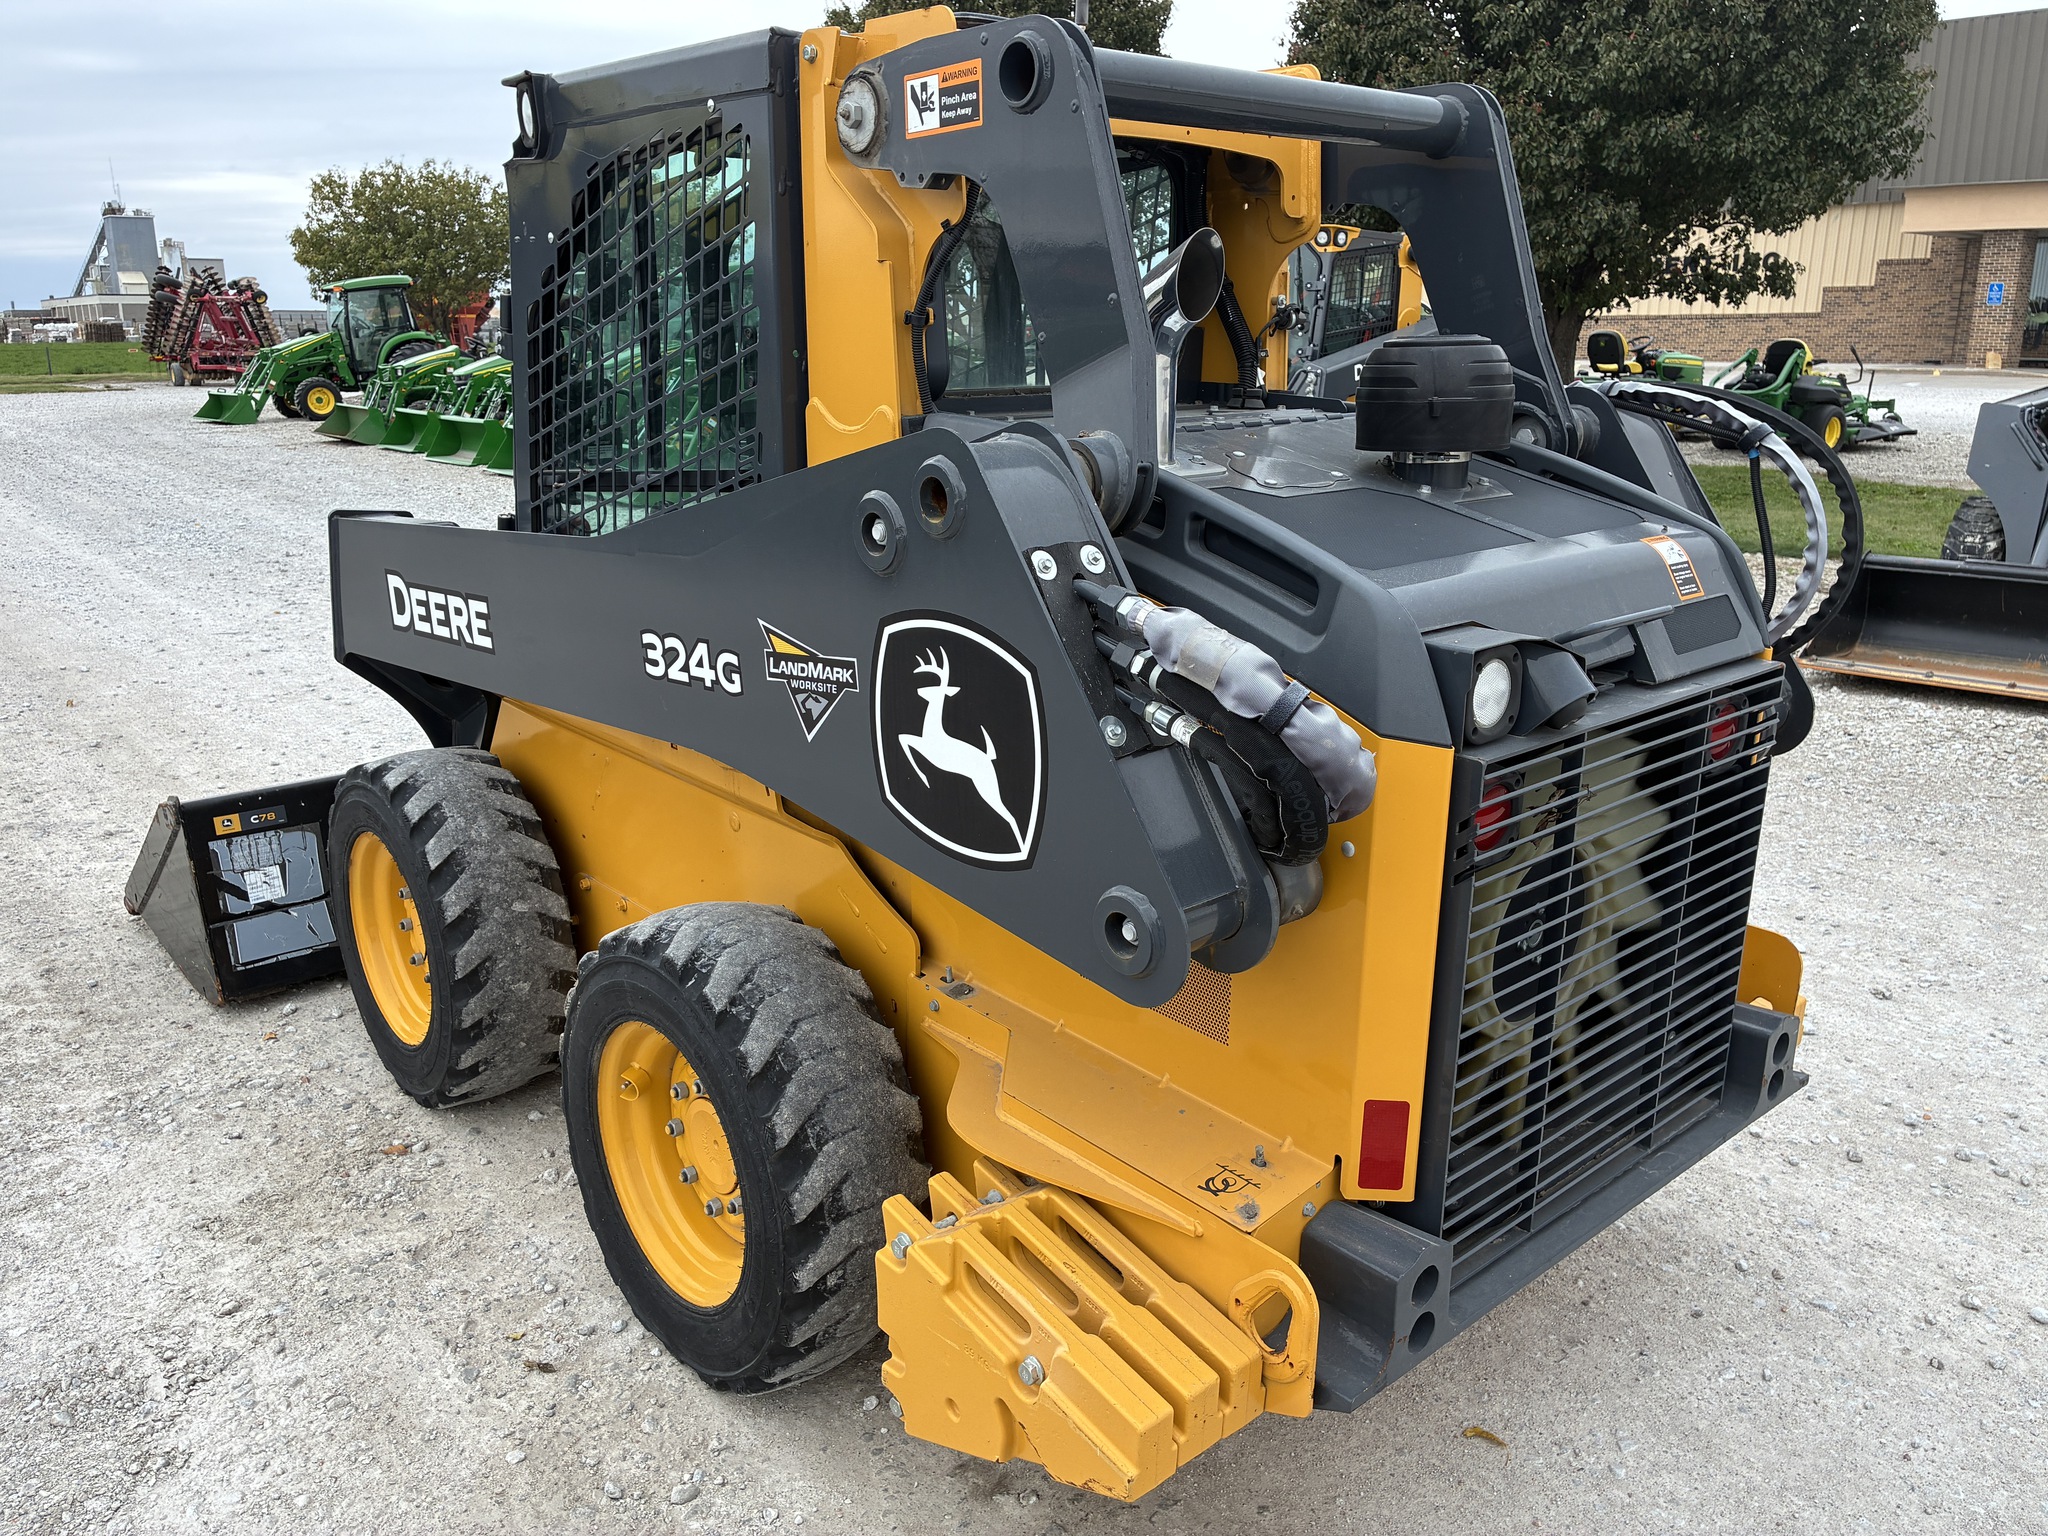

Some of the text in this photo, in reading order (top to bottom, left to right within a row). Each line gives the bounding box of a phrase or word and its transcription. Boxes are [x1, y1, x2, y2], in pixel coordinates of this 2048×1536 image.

[947, 66, 978, 81] WARNING
[941, 91, 977, 106] Pinch Area
[941, 106, 973, 119] Keep Away
[386, 573, 493, 649] DEERE
[641, 632, 743, 695] 324G
[790, 678, 838, 694] WORKSITE
[1266, 757, 1320, 843] Aeroquip
[250, 811, 276, 824] C78
